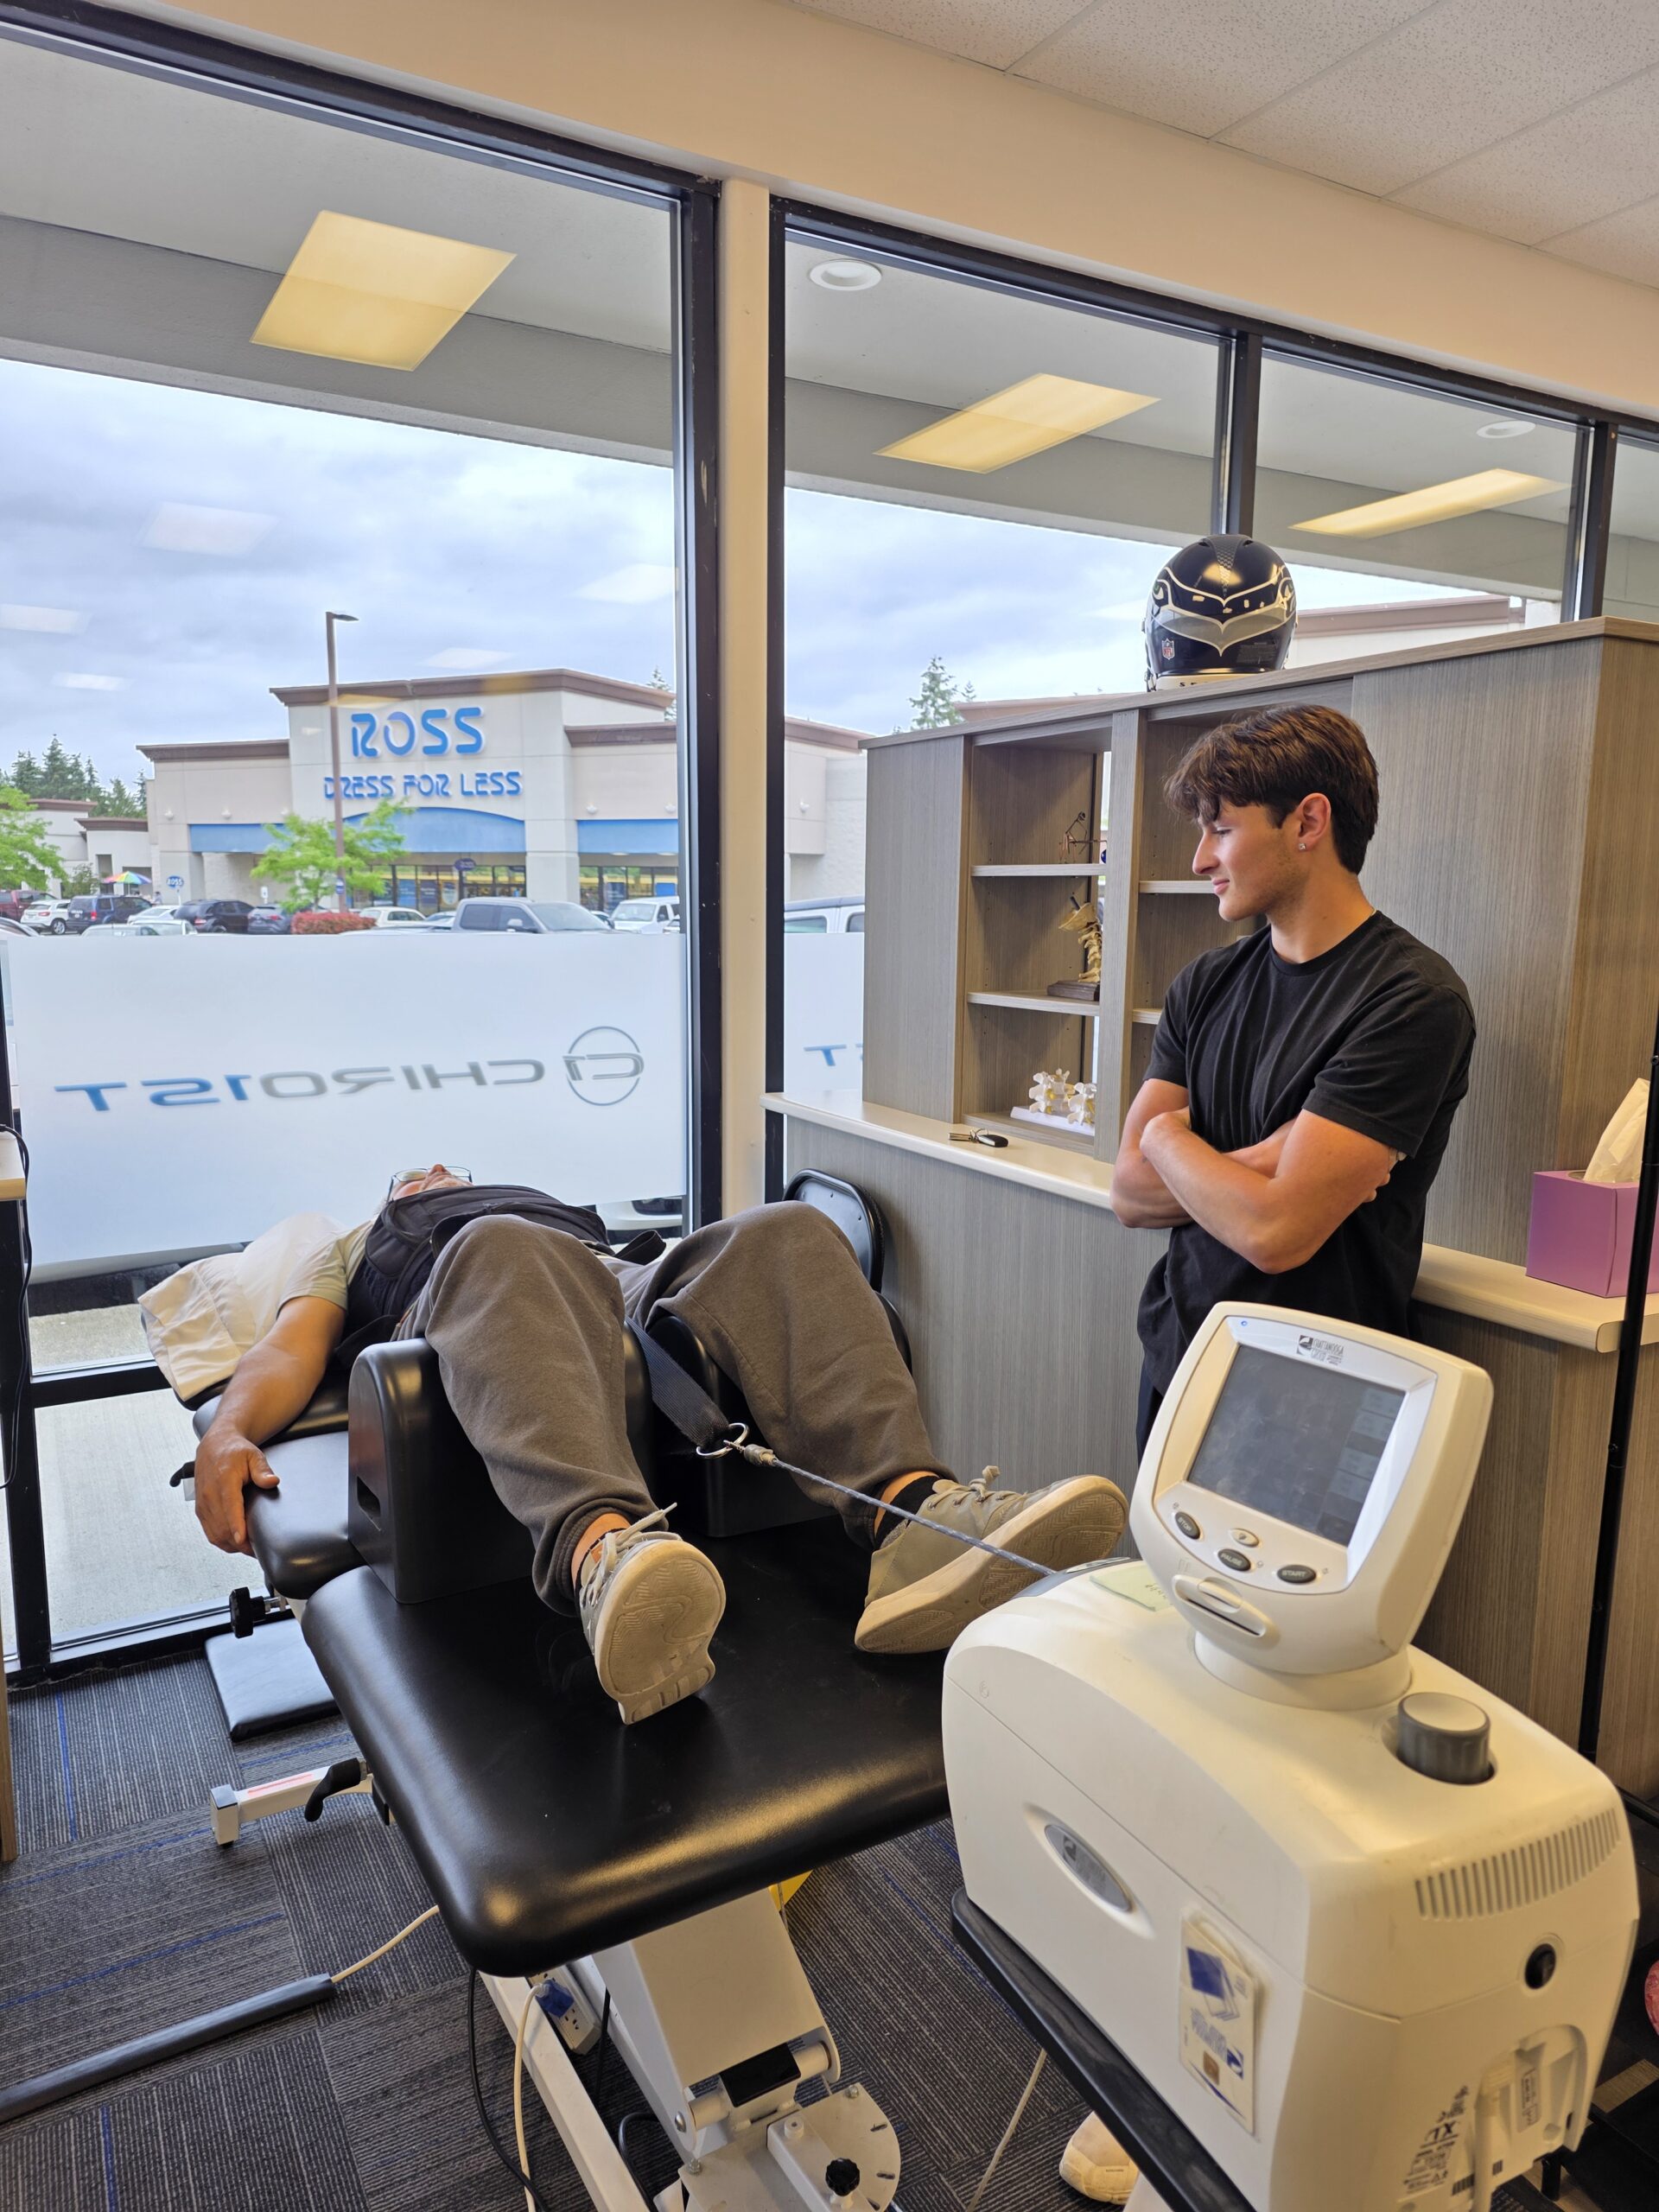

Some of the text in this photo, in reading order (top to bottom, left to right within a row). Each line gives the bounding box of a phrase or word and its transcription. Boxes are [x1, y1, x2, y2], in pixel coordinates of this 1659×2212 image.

[350, 706, 483, 759] ROSS
[324, 771, 522, 799] DRESS FOR LESS
[1177, 1516, 1192, 1531] STOP
[1220, 1552, 1243, 1567] PAUSE
[1281, 1569, 1306, 1578] START
